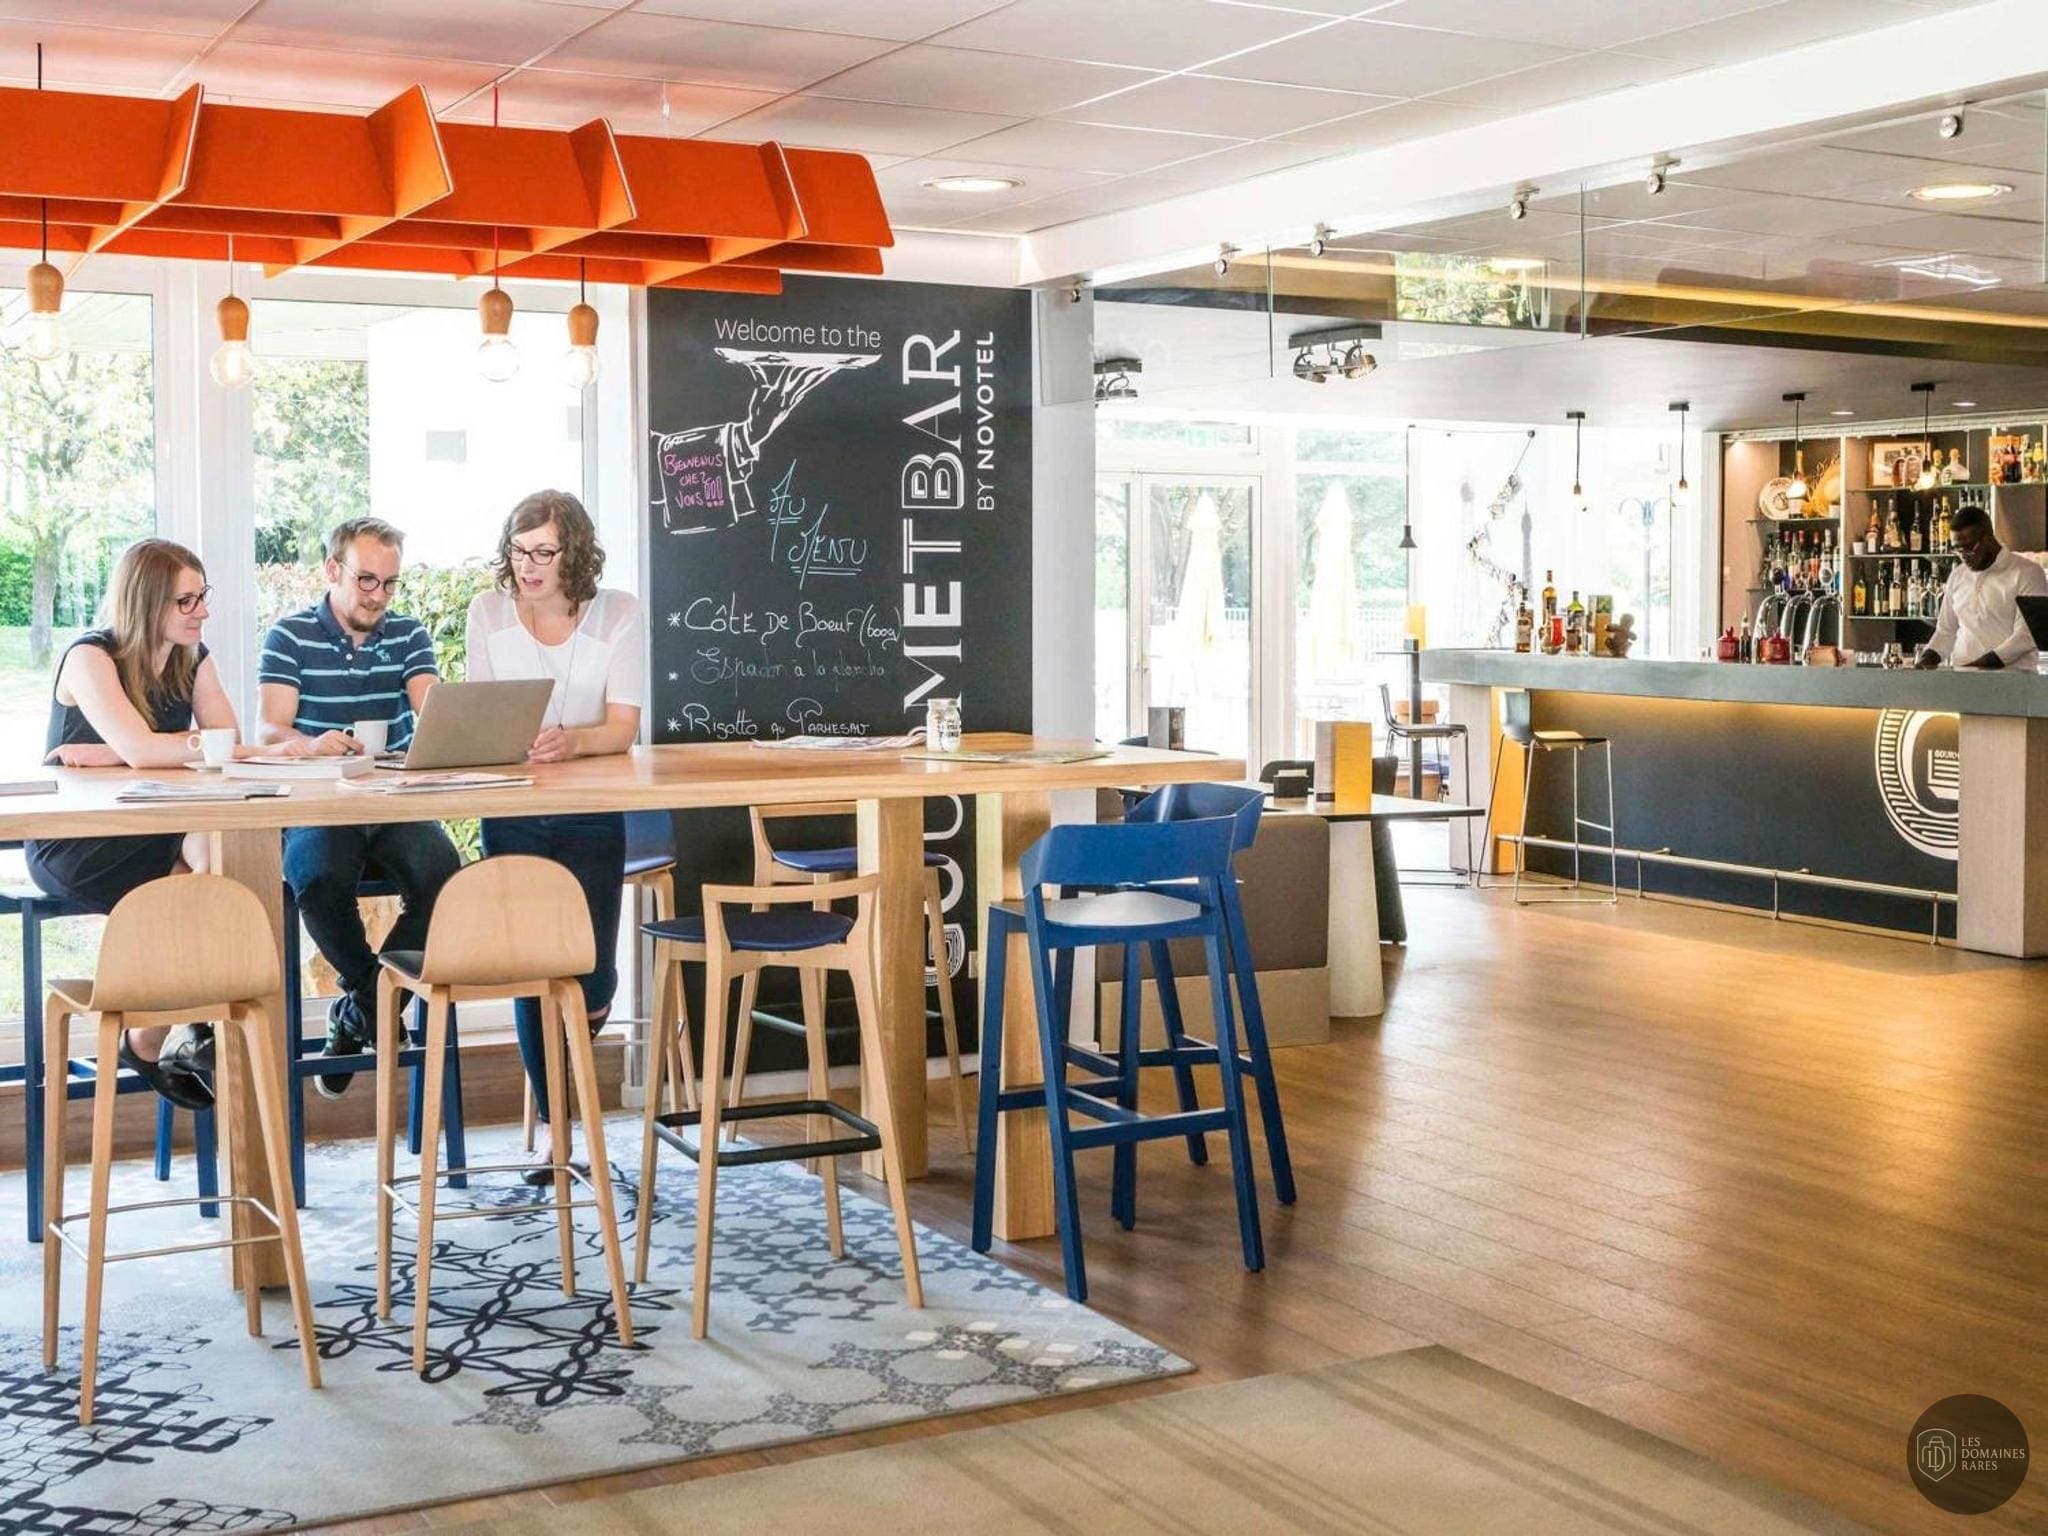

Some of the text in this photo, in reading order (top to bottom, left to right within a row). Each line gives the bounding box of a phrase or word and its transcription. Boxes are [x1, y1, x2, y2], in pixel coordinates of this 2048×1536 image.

[714, 318, 882, 348] Welcome to the
[977, 331, 995, 511] BY NOVOTEL
[682, 703, 758, 740] Risotto
